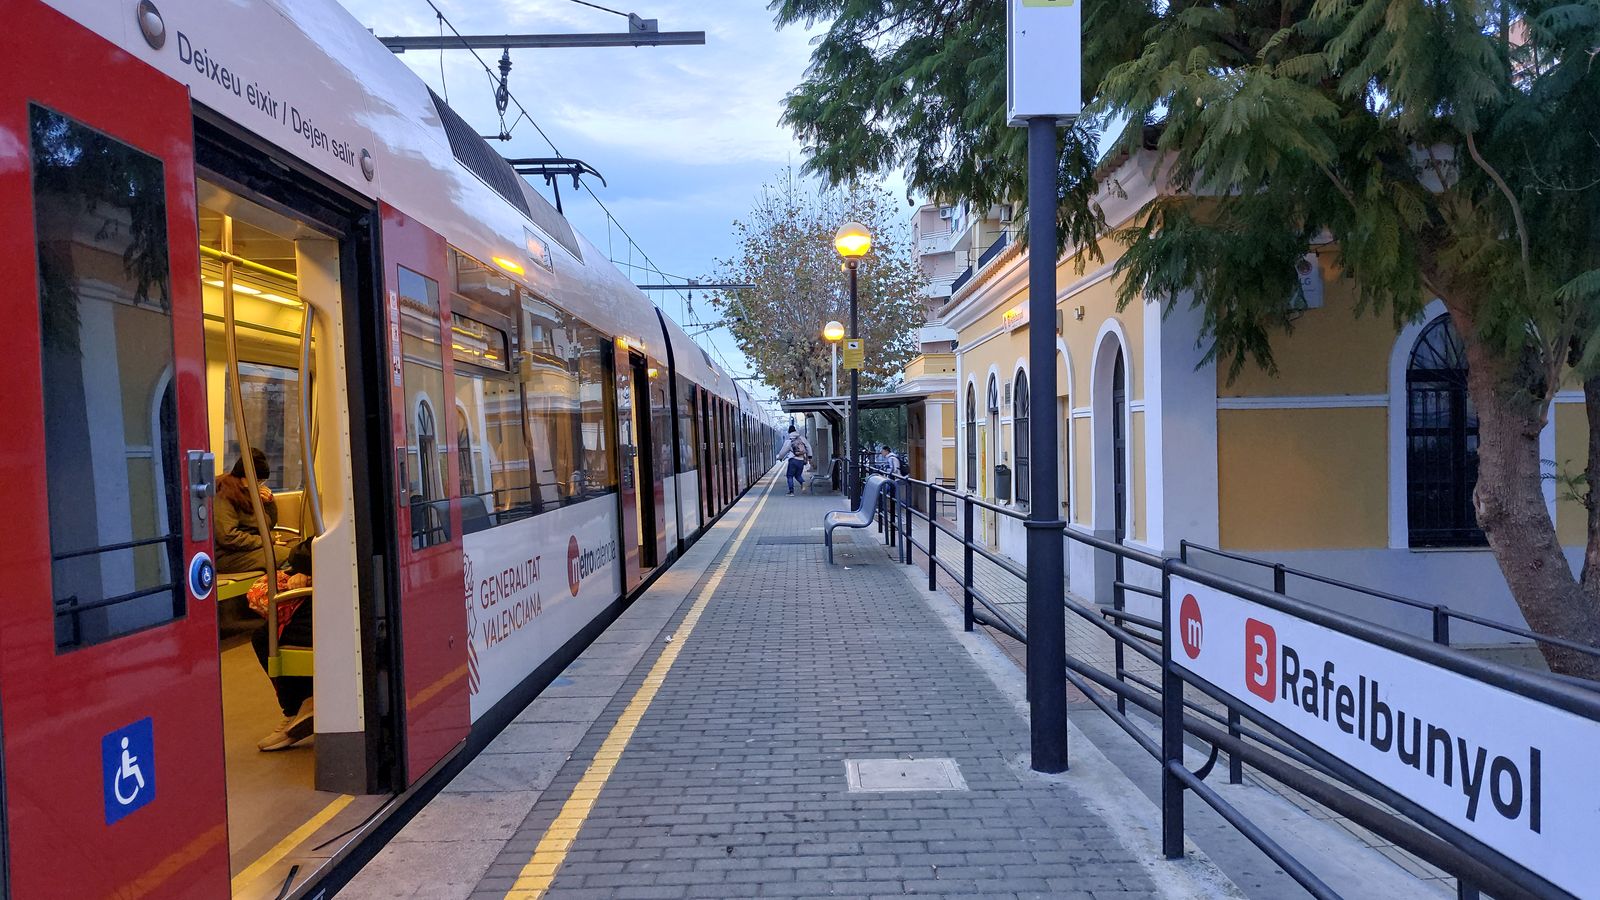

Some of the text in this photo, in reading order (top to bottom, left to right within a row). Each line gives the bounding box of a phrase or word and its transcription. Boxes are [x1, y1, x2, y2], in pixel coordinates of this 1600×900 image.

[177, 30, 355, 167] Deixeu eixir / Dejen salir
[480, 555, 541, 609] GENERALITAT
[482, 592, 542, 649] VALENCIANA
[1253, 634, 1541, 834] 3 Rafelbunyol
